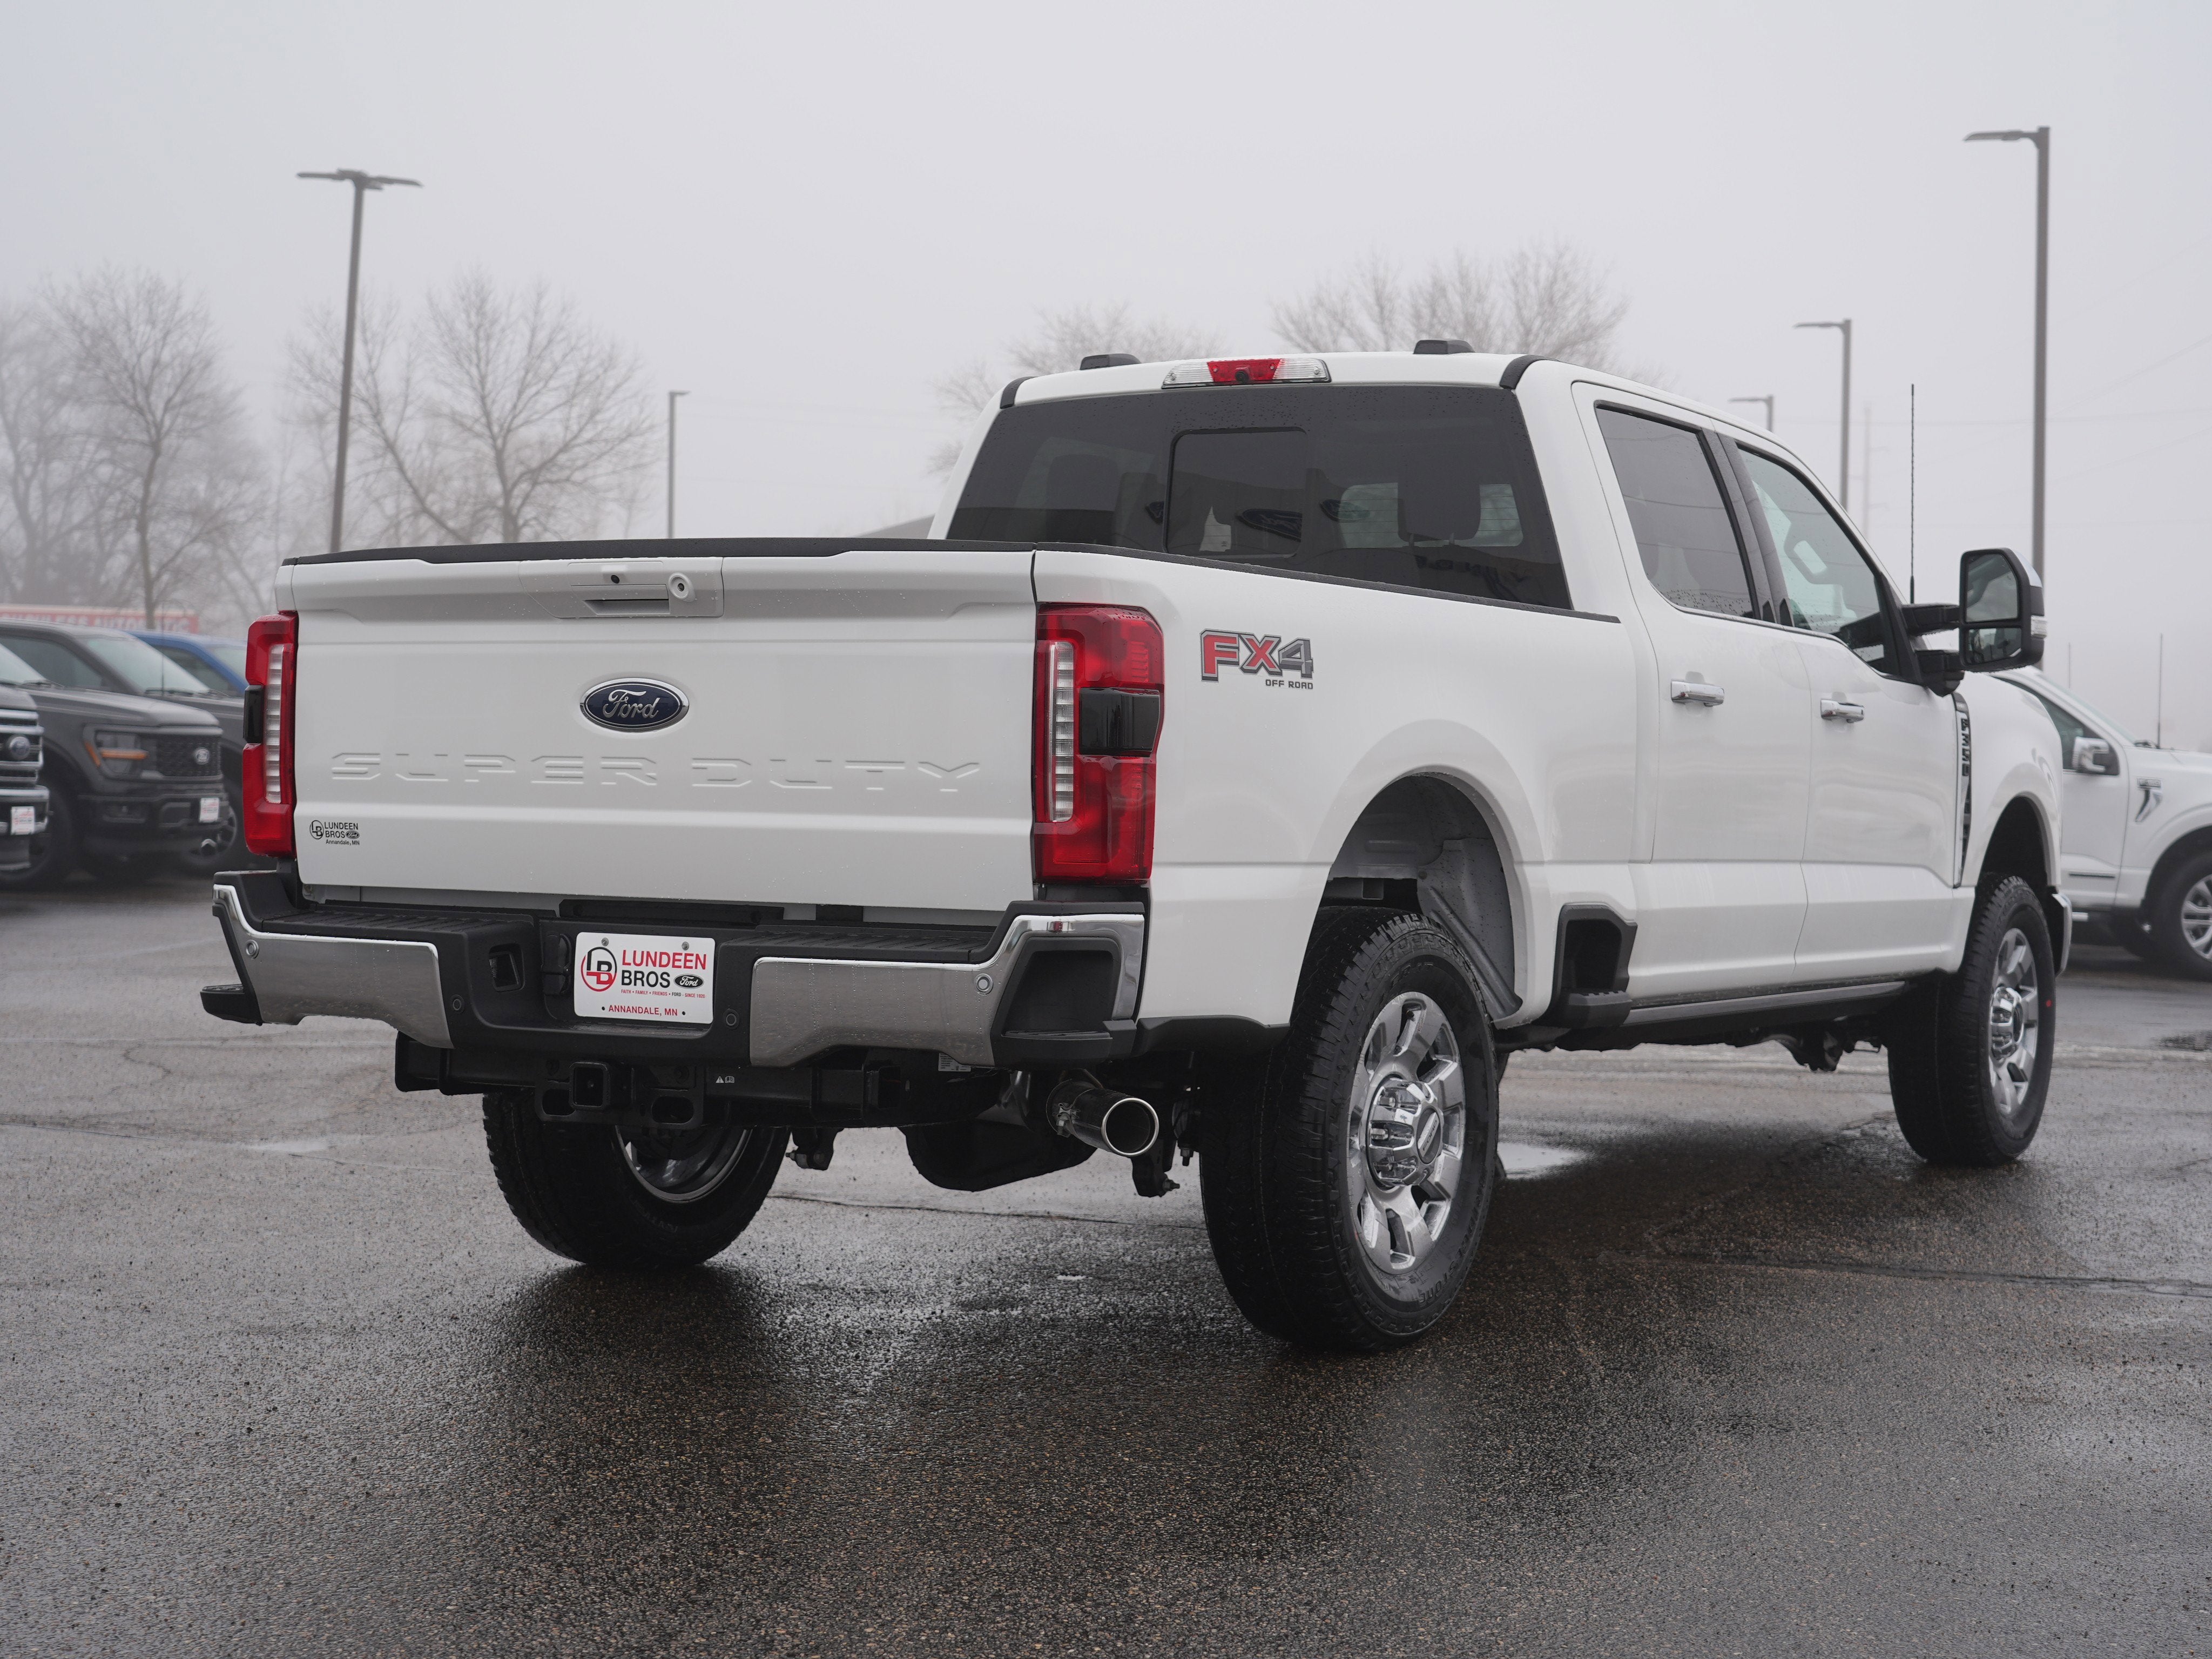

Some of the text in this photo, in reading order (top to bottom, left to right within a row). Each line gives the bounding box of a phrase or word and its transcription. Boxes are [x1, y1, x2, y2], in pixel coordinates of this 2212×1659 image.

[1199, 629, 1314, 683] FX4
[1288, 681, 1313, 690] ROAD
[603, 689, 660, 718] Ford
[332, 752, 980, 792] SUPER DUTY
[325, 821, 359, 830] LUNDEEN
[325, 830, 345, 838] BROS
[622, 949, 707, 970] LUNDEEN
[621, 970, 699, 988] BROS Ford
[609, 1004, 678, 1016] ANNANDALE, MN
[1422, 1120, 1437, 1151] FORD
